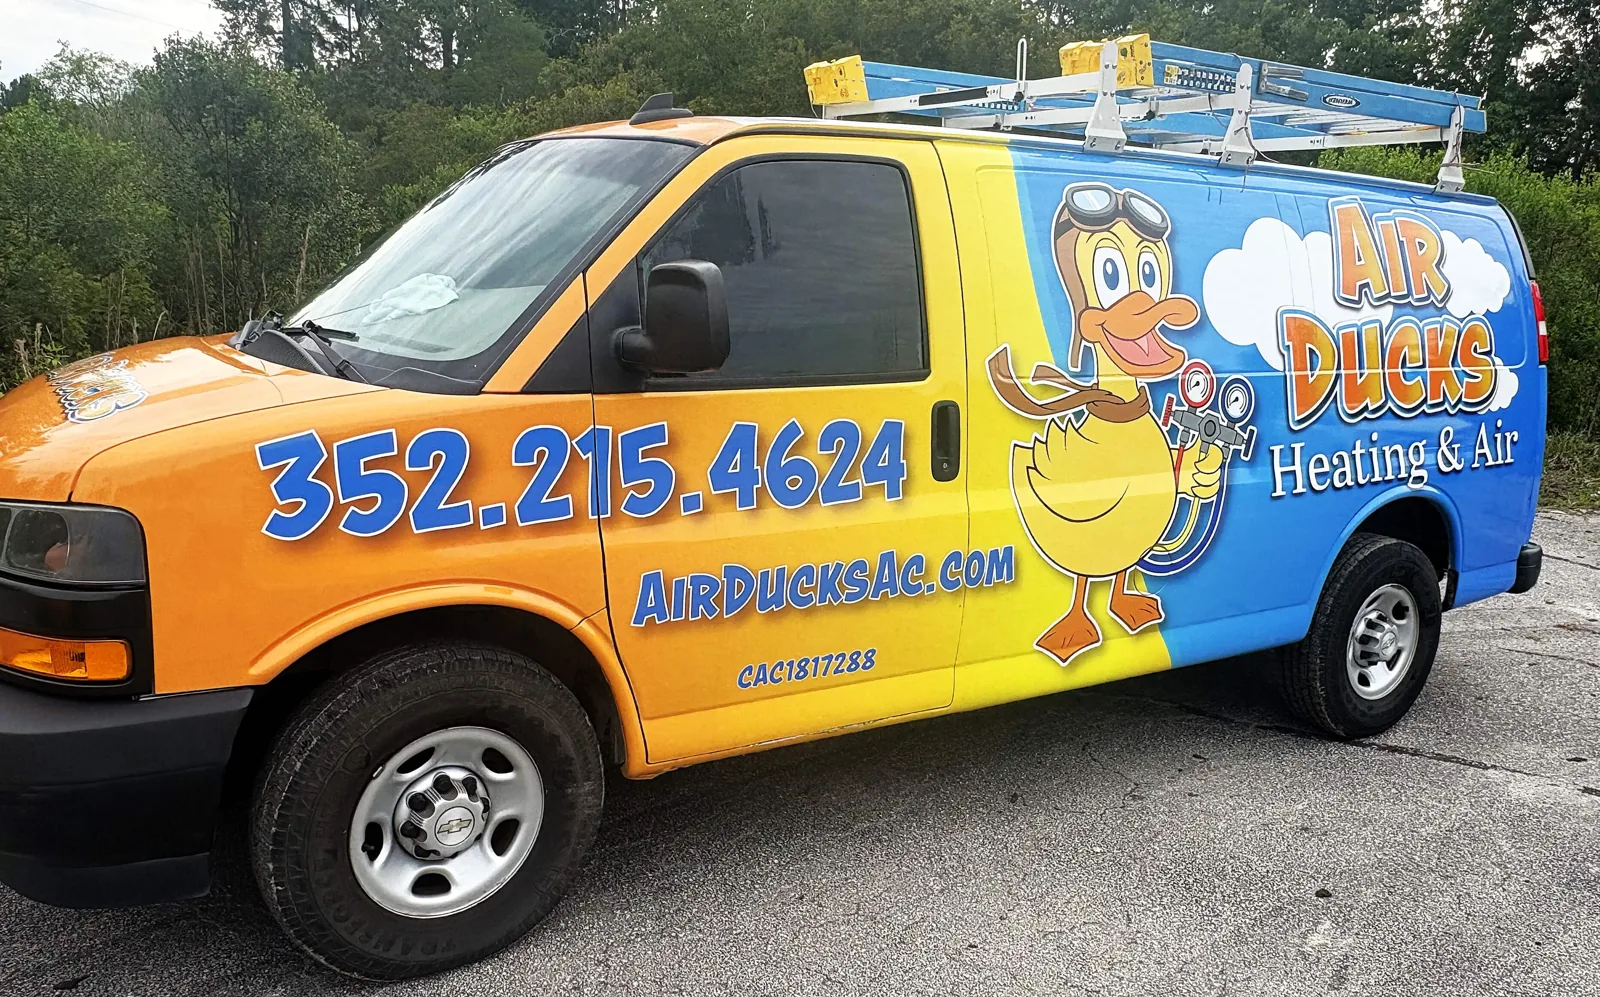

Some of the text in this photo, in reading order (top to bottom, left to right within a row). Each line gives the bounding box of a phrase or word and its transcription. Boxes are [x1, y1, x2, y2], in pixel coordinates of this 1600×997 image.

[1328, 196, 1452, 307] AIR
[1278, 306, 1497, 430] DUCKS
[255, 418, 907, 541] 352.215.4624
[1270, 419, 1518, 497] Heating & Air
[630, 545, 1014, 627] AIRDUCKSAC.COM
[737, 648, 877, 690] CAC1817288
